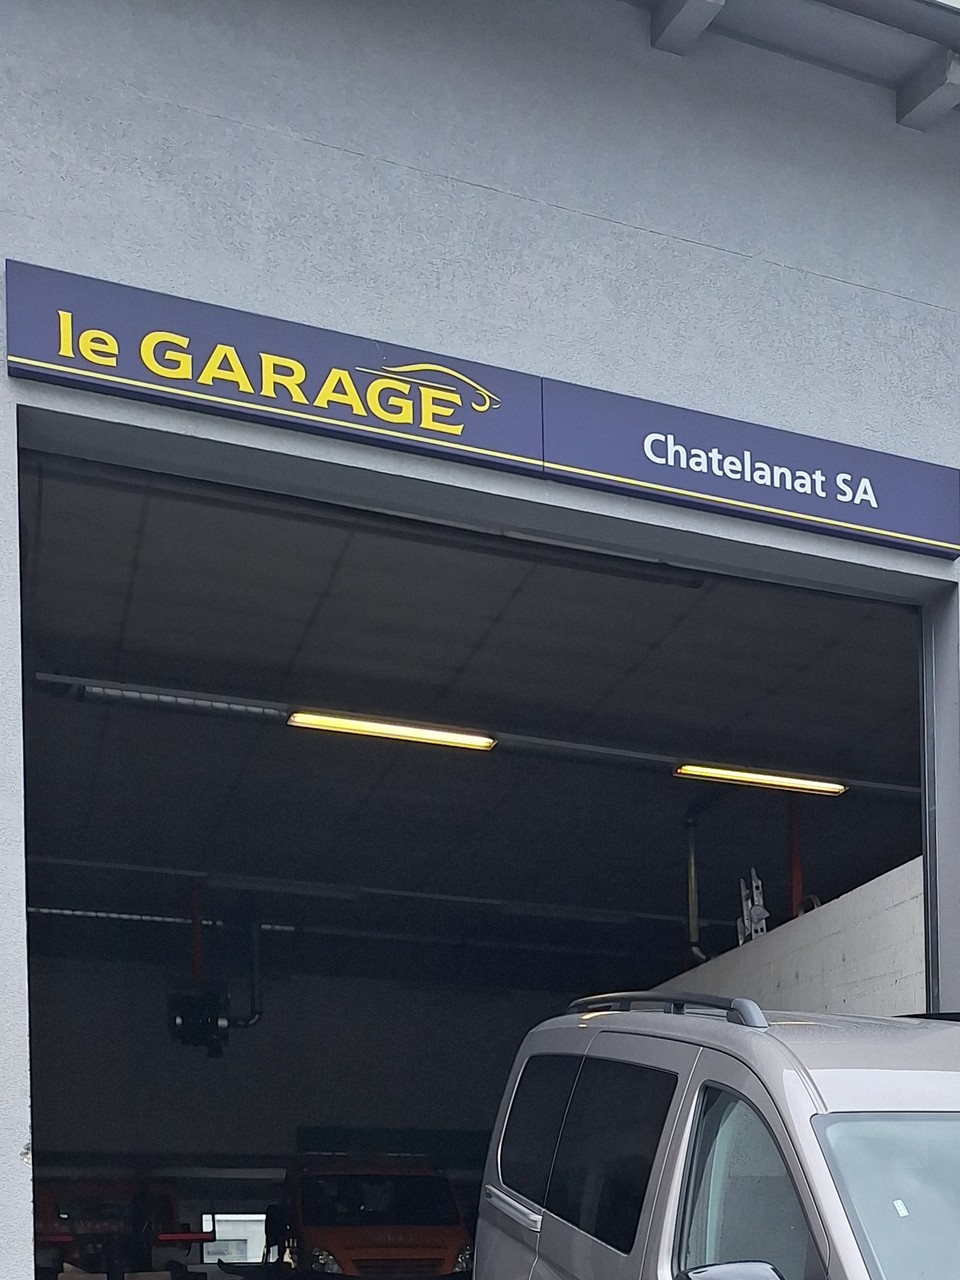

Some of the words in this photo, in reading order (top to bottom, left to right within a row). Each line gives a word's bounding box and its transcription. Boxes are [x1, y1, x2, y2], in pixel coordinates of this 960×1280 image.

[57, 309, 118, 368] le
[140, 328, 466, 437] GARAGE
[642, 430, 828, 500] Chatelanat
[834, 471, 880, 509] SA
